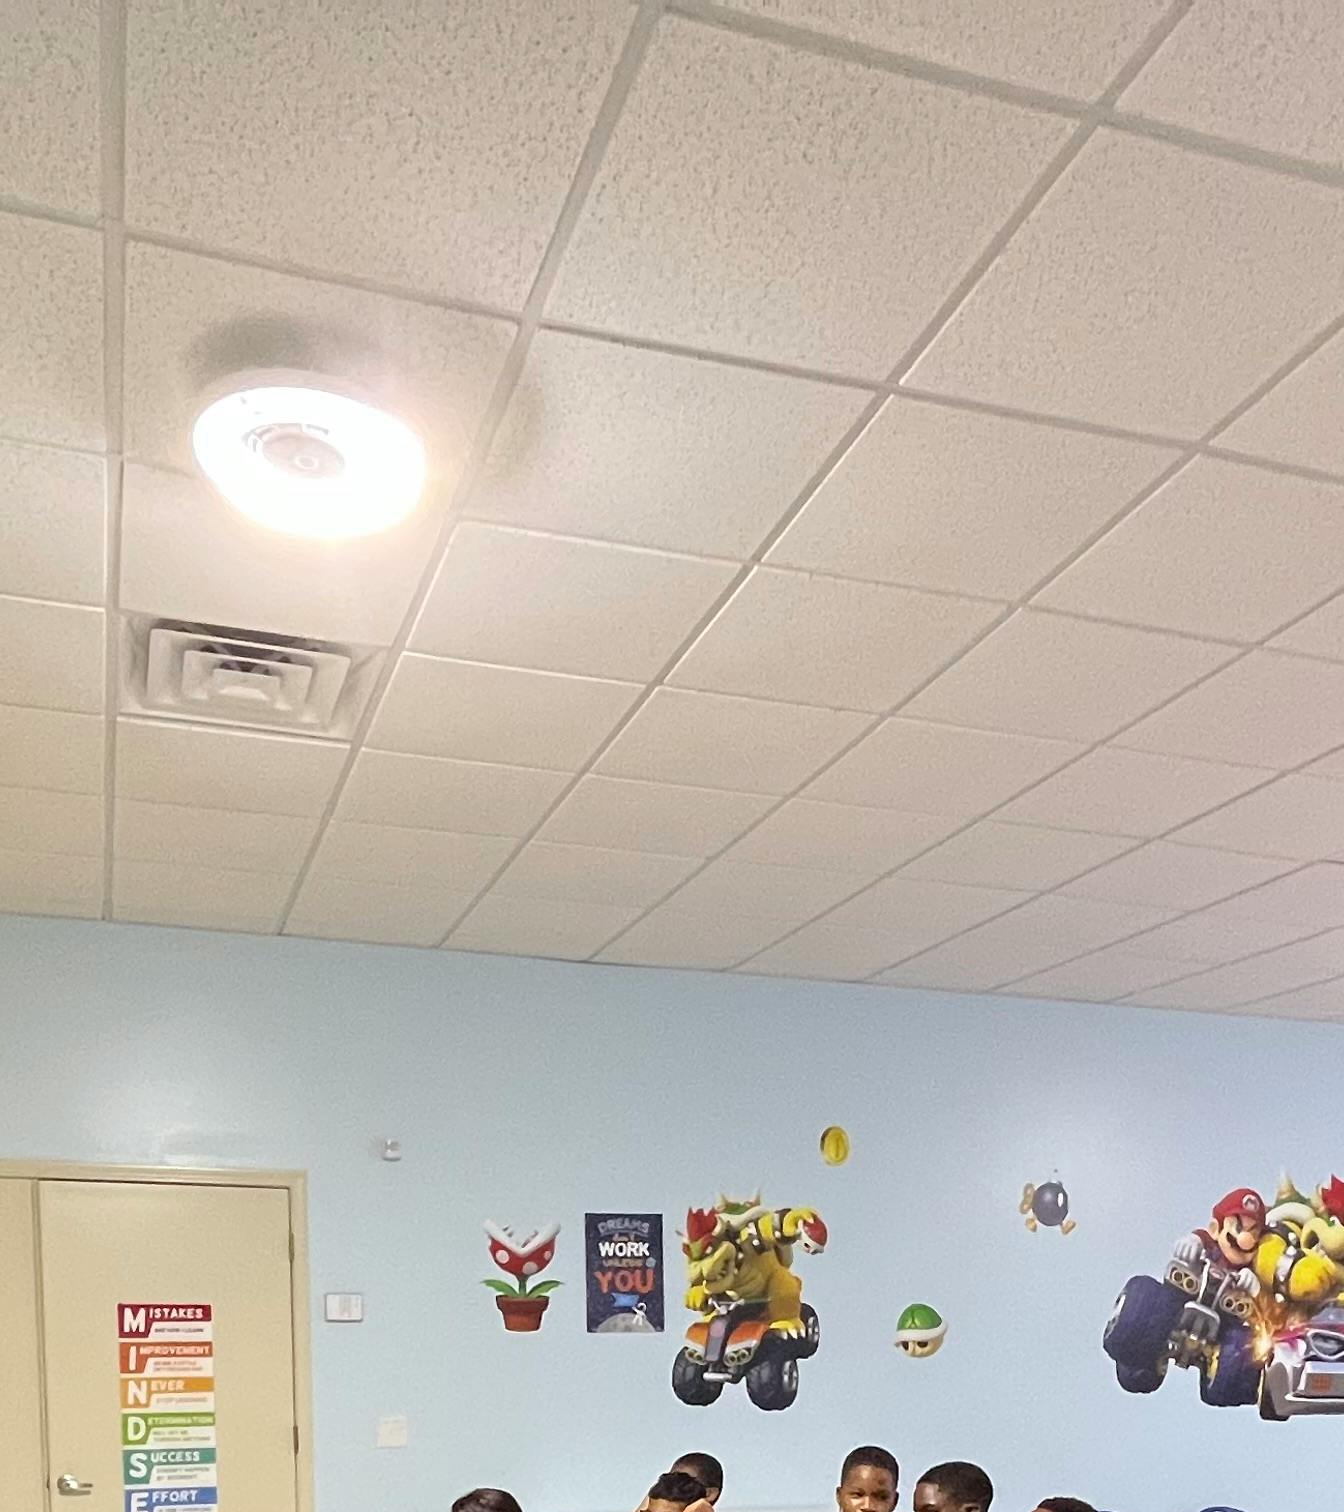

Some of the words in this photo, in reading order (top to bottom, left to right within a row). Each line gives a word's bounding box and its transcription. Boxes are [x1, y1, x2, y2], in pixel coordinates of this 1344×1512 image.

[598, 1241, 650, 1257] WORK
[594, 1269, 655, 1293] YOU
[123, 1307, 204, 1333] MISTAKES
[127, 1379, 185, 1405] NEVER
[129, 1451, 201, 1479] SUCCESS
